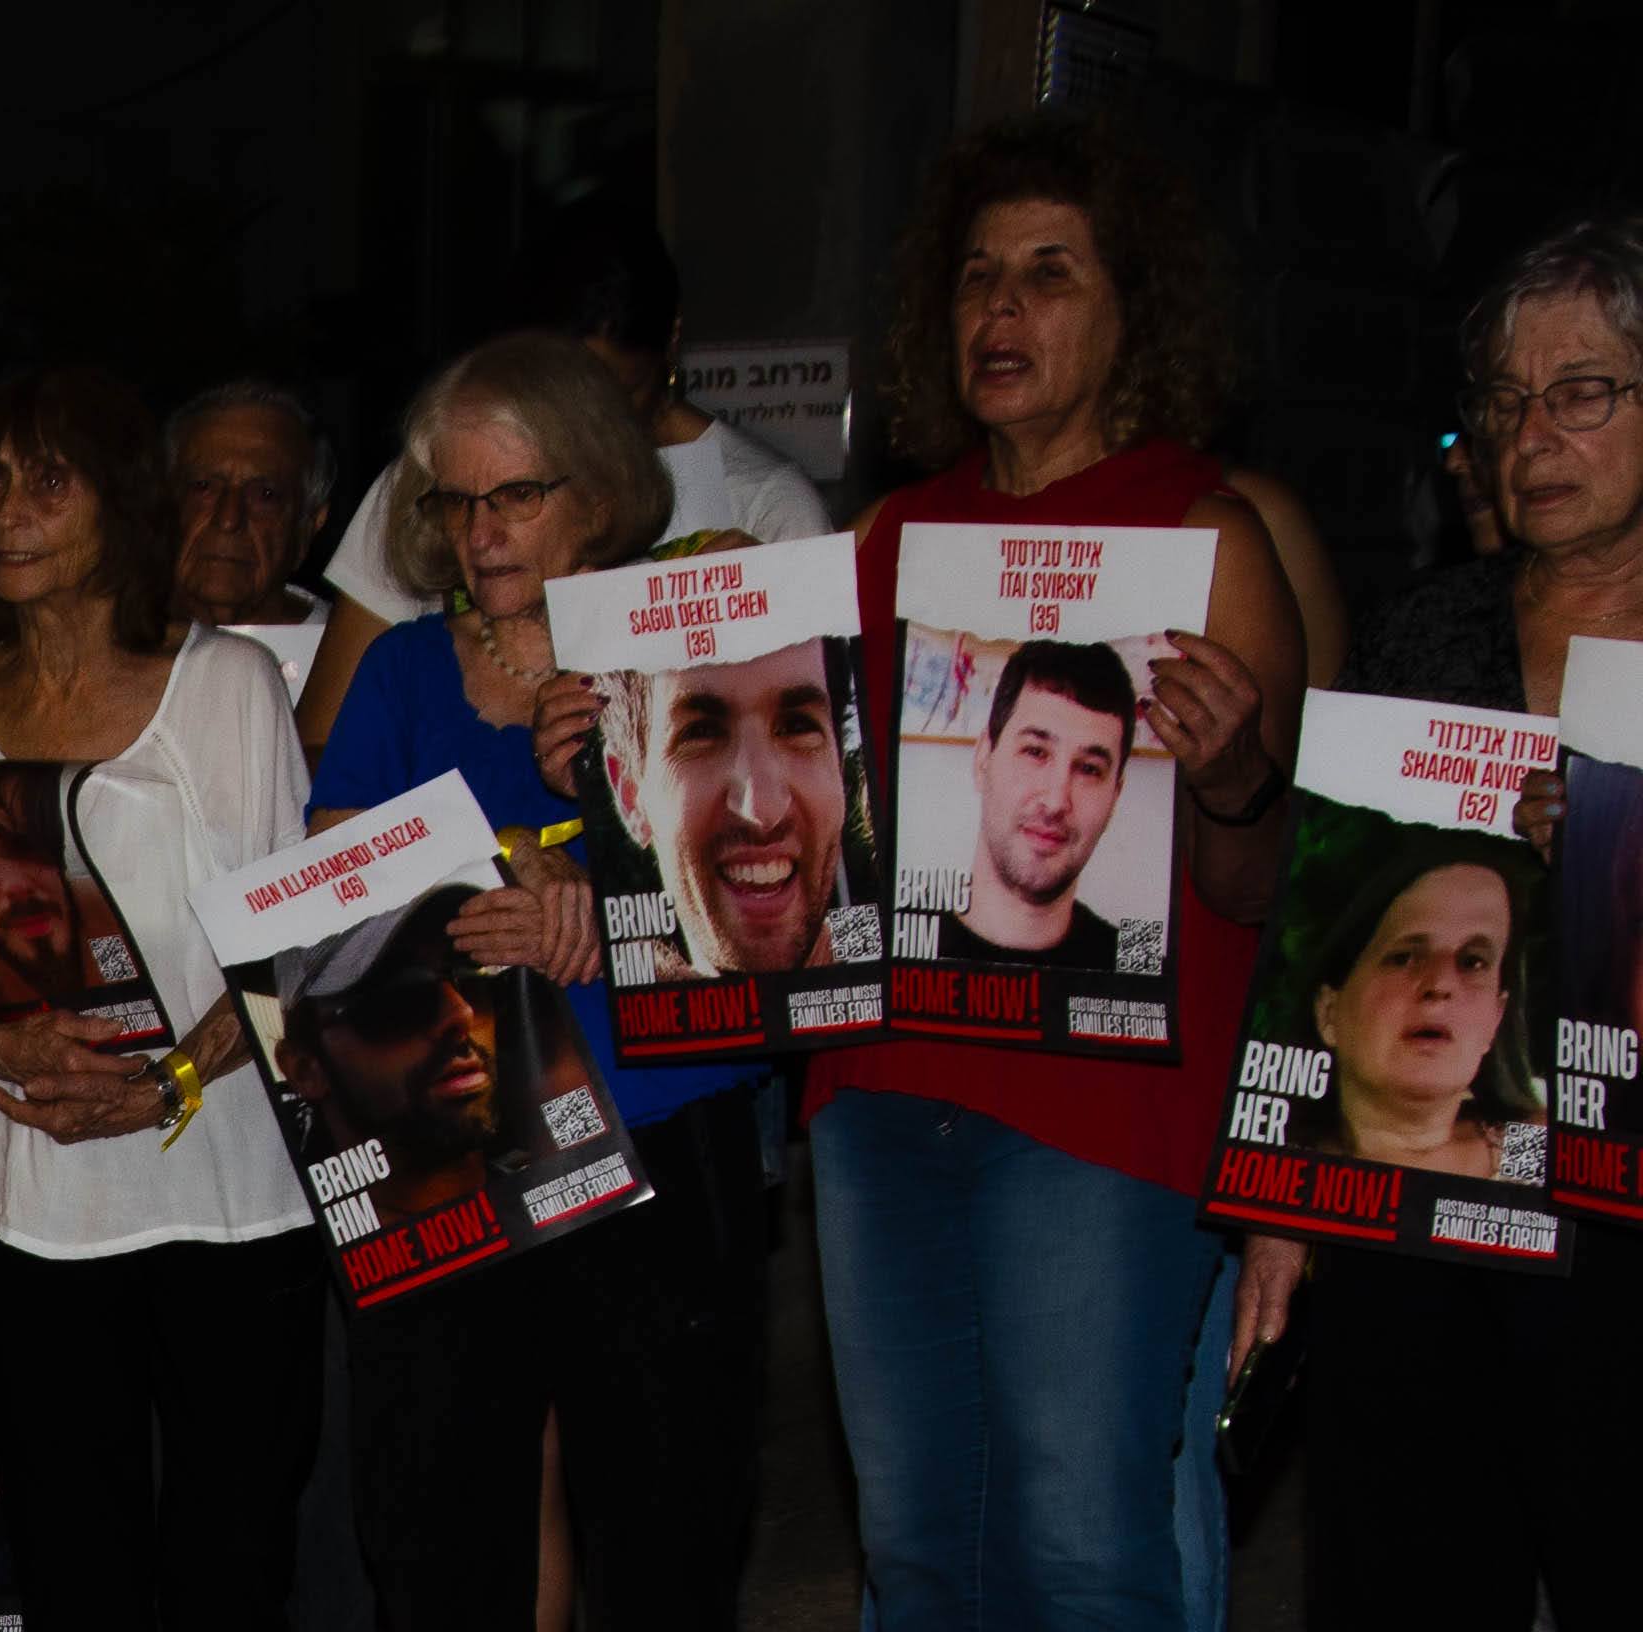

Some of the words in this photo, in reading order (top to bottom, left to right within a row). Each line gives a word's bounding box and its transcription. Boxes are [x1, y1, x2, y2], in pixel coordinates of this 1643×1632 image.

[744, 361, 832, 387] מרחב
[1000, 539, 1062, 567] סבירסקי
[1066, 541, 1103, 567] איתי
[647, 576, 663, 604] חן
[669, 571, 698, 598] דקל
[999, 572, 1025, 598] ITAI
[1031, 572, 1097, 600] SVIRSKY
[629, 606, 675, 635] SAGUI
[678, 597, 724, 628] DEKEL
[727, 589, 768, 620] CHEN
[1030, 602, 1060, 634] (35)
[686, 629, 716, 659] (35)
[1428, 719, 1507, 756] אביגדורי
[1511, 732, 1556, 762] שרון
[1401, 750, 1478, 786] SHARON
[1458, 789, 1498, 825] (52)
[245, 882, 284, 914] IVAN
[280, 843, 377, 899] ILLARAMENDI
[371, 815, 431, 860] SAIZAR
[332, 876, 370, 906] (46)
[895, 867, 973, 915] BRING
[604, 890, 677, 941] BRING
[891, 912, 940, 961] HIM
[610, 940, 656, 988] HIM
[618, 990, 684, 1041] HOME
[686, 975, 762, 1033] NOW!
[788, 989, 832, 1009] HOSTAGES
[833, 987, 851, 1002] AND
[788, 1002, 846, 1029] FAMILIES
[891, 967, 962, 1018] HOME
[966, 969, 1041, 1025] NOW!
[1068, 995, 1110, 1013] HOSTAGES
[1110, 998, 1127, 1013] AND
[1128, 1000, 1166, 1018] MISSING
[127, 1011, 162, 1032] FORUM
[1069, 1011, 1123, 1038] FAMILIES
[1124, 1015, 1167, 1040] FORUM
[1555, 1018, 1639, 1081] BRING
[1237, 1039, 1332, 1102] BRING
[1227, 1090, 1291, 1147] HER
[1554, 1072, 1607, 1131] HER
[307, 1138, 392, 1206] BRING
[1553, 1132, 1631, 1197] HOME
[528, 1183, 588, 1226] FAMILIES
[587, 1166, 635, 1201] FORUM
[1215, 1146, 1310, 1208] HOME
[1312, 1162, 1404, 1225] NOW!
[323, 1192, 382, 1247] HIM
[1434, 1197, 1488, 1220] HOSTAGES
[1488, 1203, 1511, 1222] AND
[1511, 1207, 1559, 1230] MISSING
[339, 1226, 422, 1292] HOME
[414, 1189, 502, 1261] NOW!
[1431, 1214, 1499, 1248] FAMILIES
[1499, 1222, 1557, 1255] FORUM
